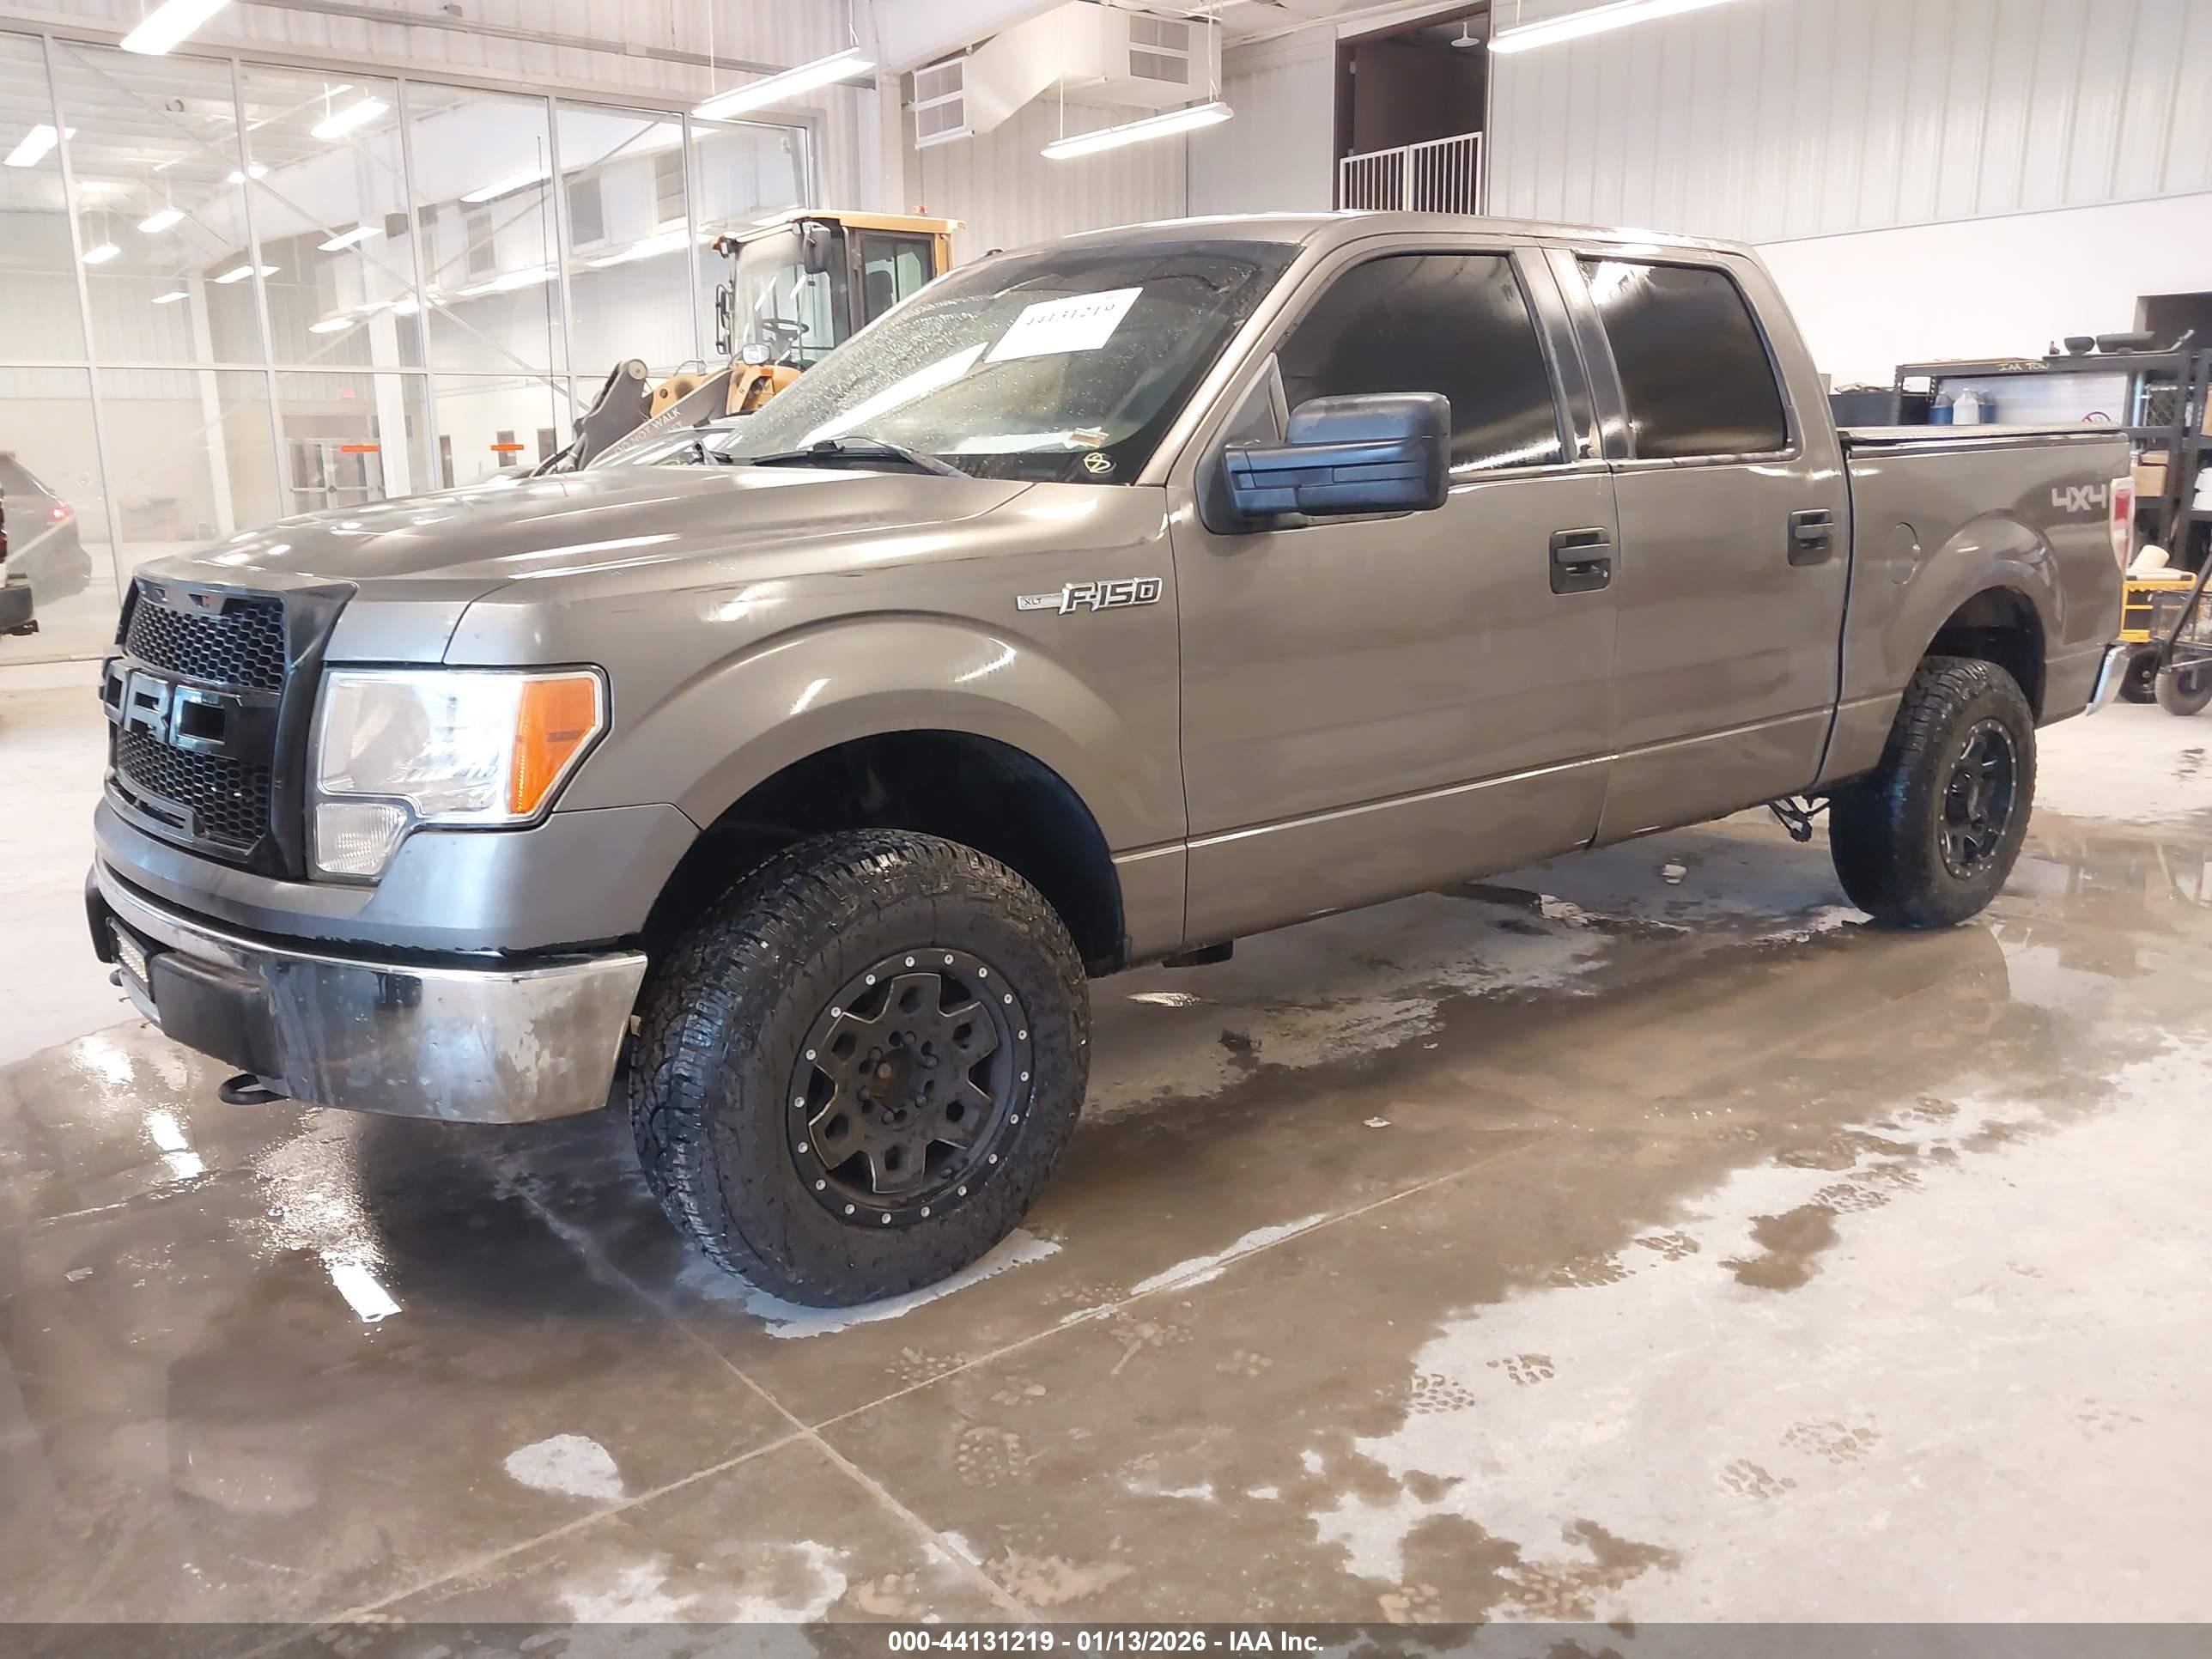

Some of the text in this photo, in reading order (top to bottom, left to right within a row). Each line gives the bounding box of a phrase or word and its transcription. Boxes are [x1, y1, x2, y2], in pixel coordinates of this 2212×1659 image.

[630, 428, 652, 442] NOT
[652, 407, 682, 430] WALK
[1024, 598, 1043, 606] XLT
[99, 659, 243, 761] ORD
